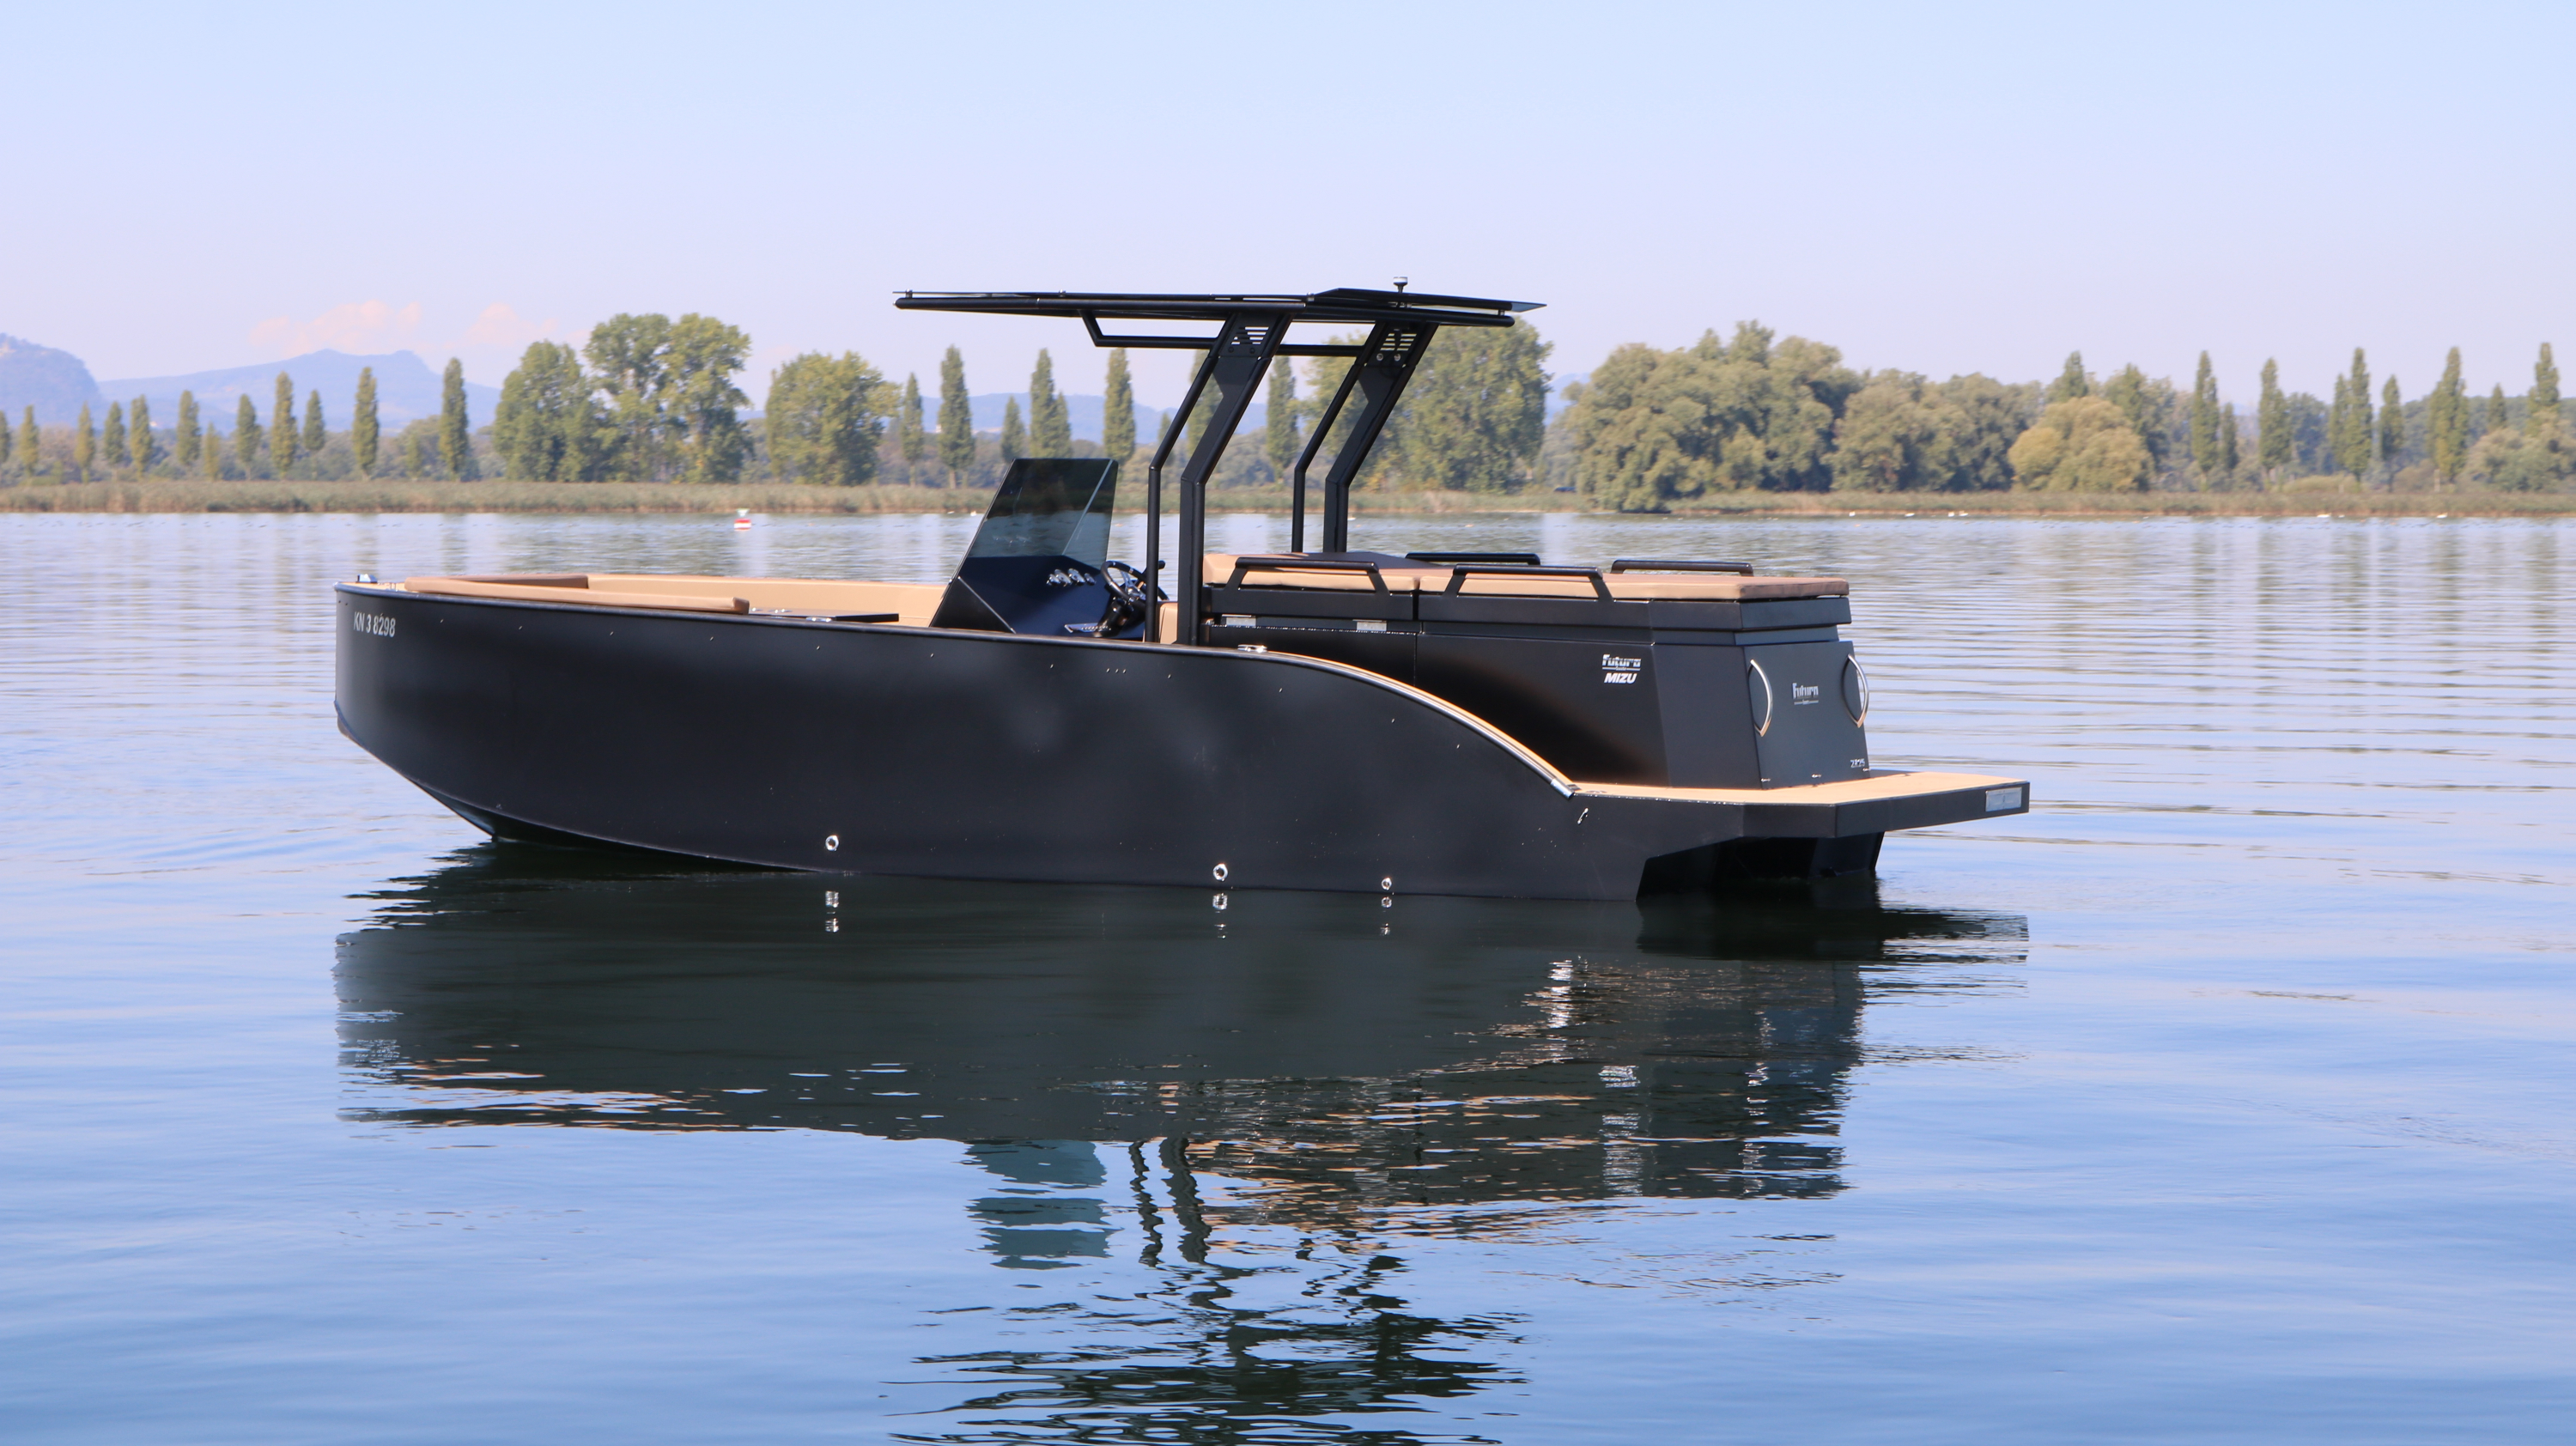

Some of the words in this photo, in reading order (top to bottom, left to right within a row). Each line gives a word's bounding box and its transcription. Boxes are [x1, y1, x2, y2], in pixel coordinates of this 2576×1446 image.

[354, 611, 365, 632] KN
[366, 613, 372, 634] 3
[373, 615, 396, 637] 8298
[1604, 672, 1637, 684] MIZU
